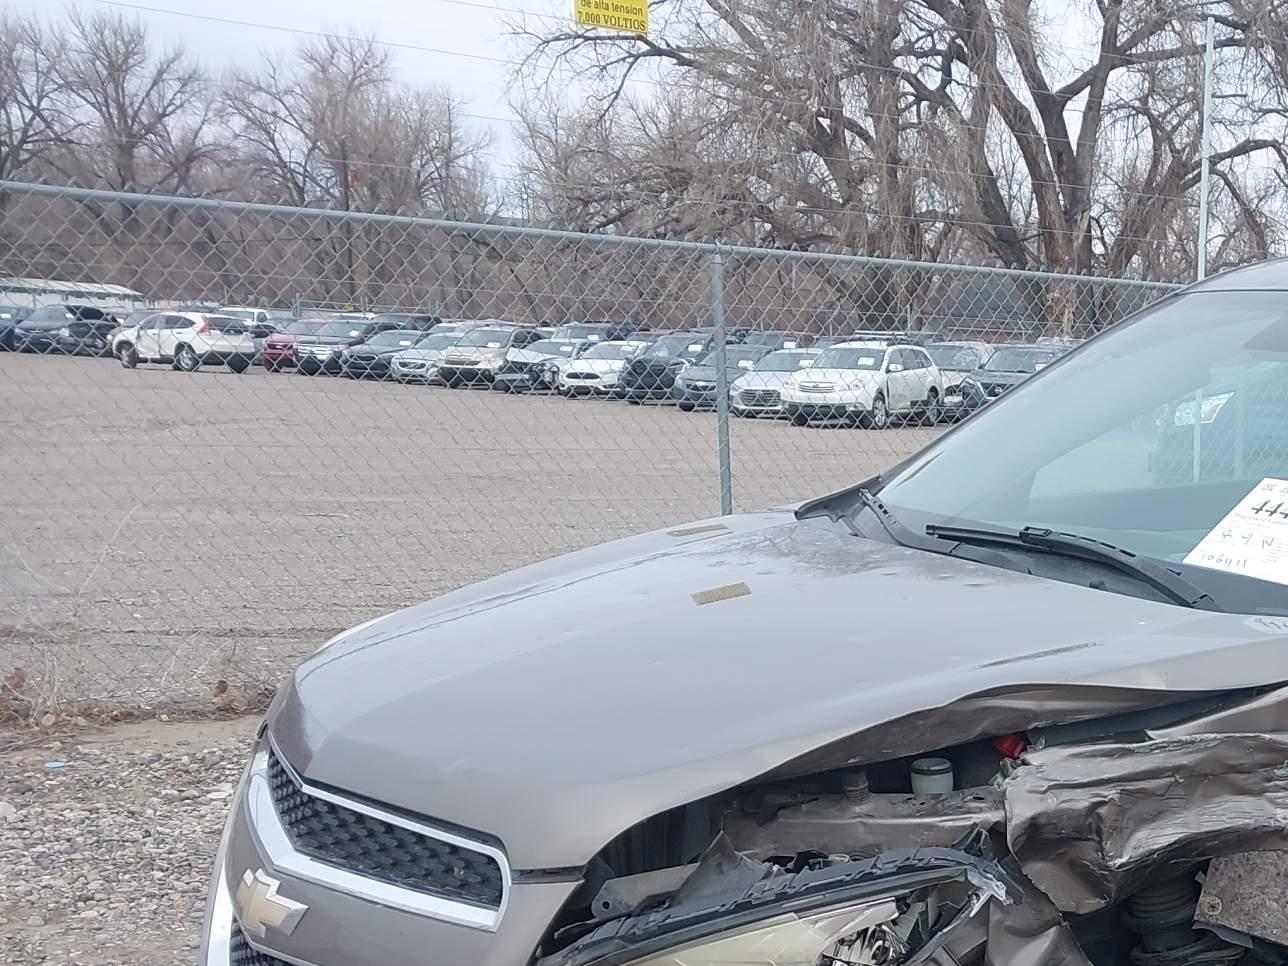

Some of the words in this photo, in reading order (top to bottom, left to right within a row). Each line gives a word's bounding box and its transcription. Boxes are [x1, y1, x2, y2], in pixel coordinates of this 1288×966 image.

[593, 0, 610, 11] alta
[611, 2, 643, 16] tension
[602, 14, 646, 31] VOLTIOS
